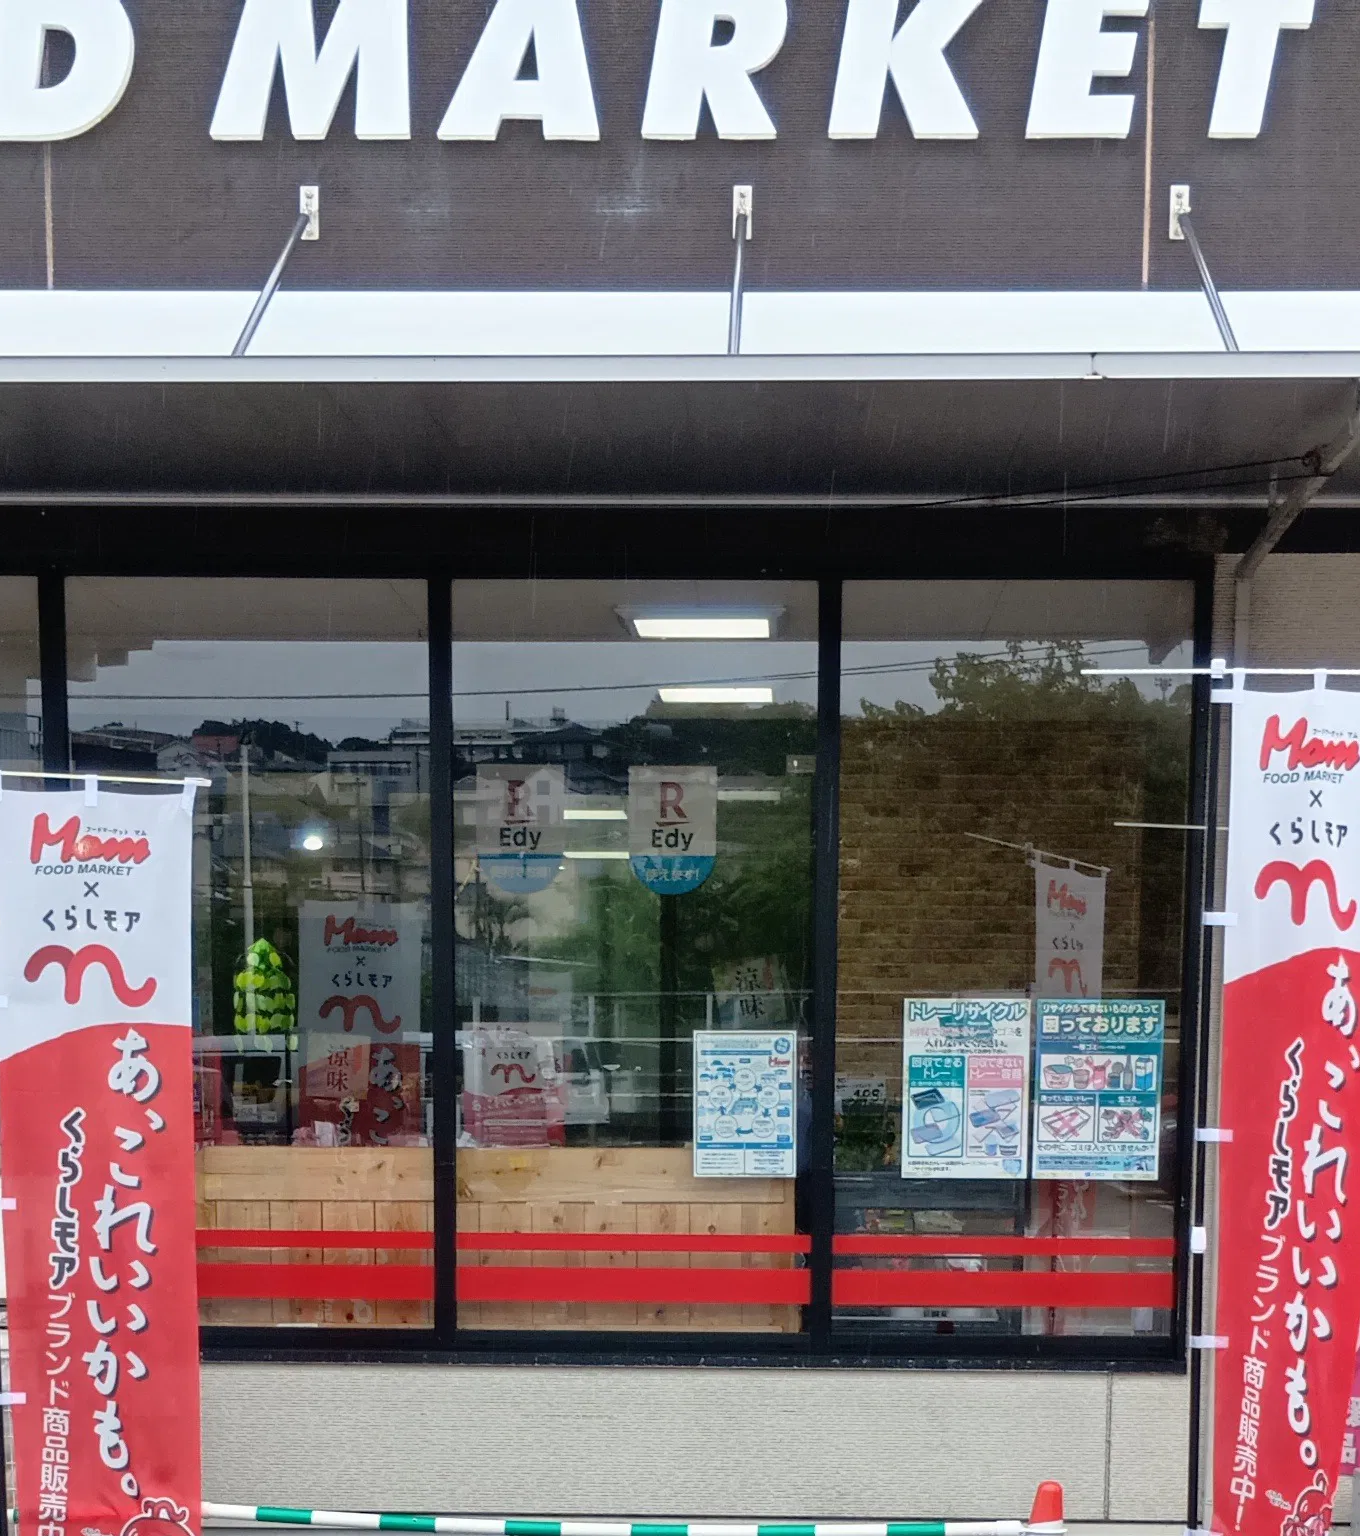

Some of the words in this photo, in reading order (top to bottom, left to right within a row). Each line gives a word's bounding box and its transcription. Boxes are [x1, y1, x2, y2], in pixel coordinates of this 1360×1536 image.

[209, 0, 1314, 141] MARKET
[1263, 772, 1300, 784] FOOD
[1304, 771, 1344, 784] MARKET
[660, 782, 688, 818] R
[500, 827, 541, 850] Edy
[652, 828, 694, 851] Edy
[34, 865, 73, 875] FOOD
[77, 864, 134, 877] MARKET
[42, 905, 141, 932] くらしモア
[332, 971, 393, 988] くらしモア
[909, 1002, 1027, 1021] トレーリサイクル
[924, 1068, 951, 1079] トレー
